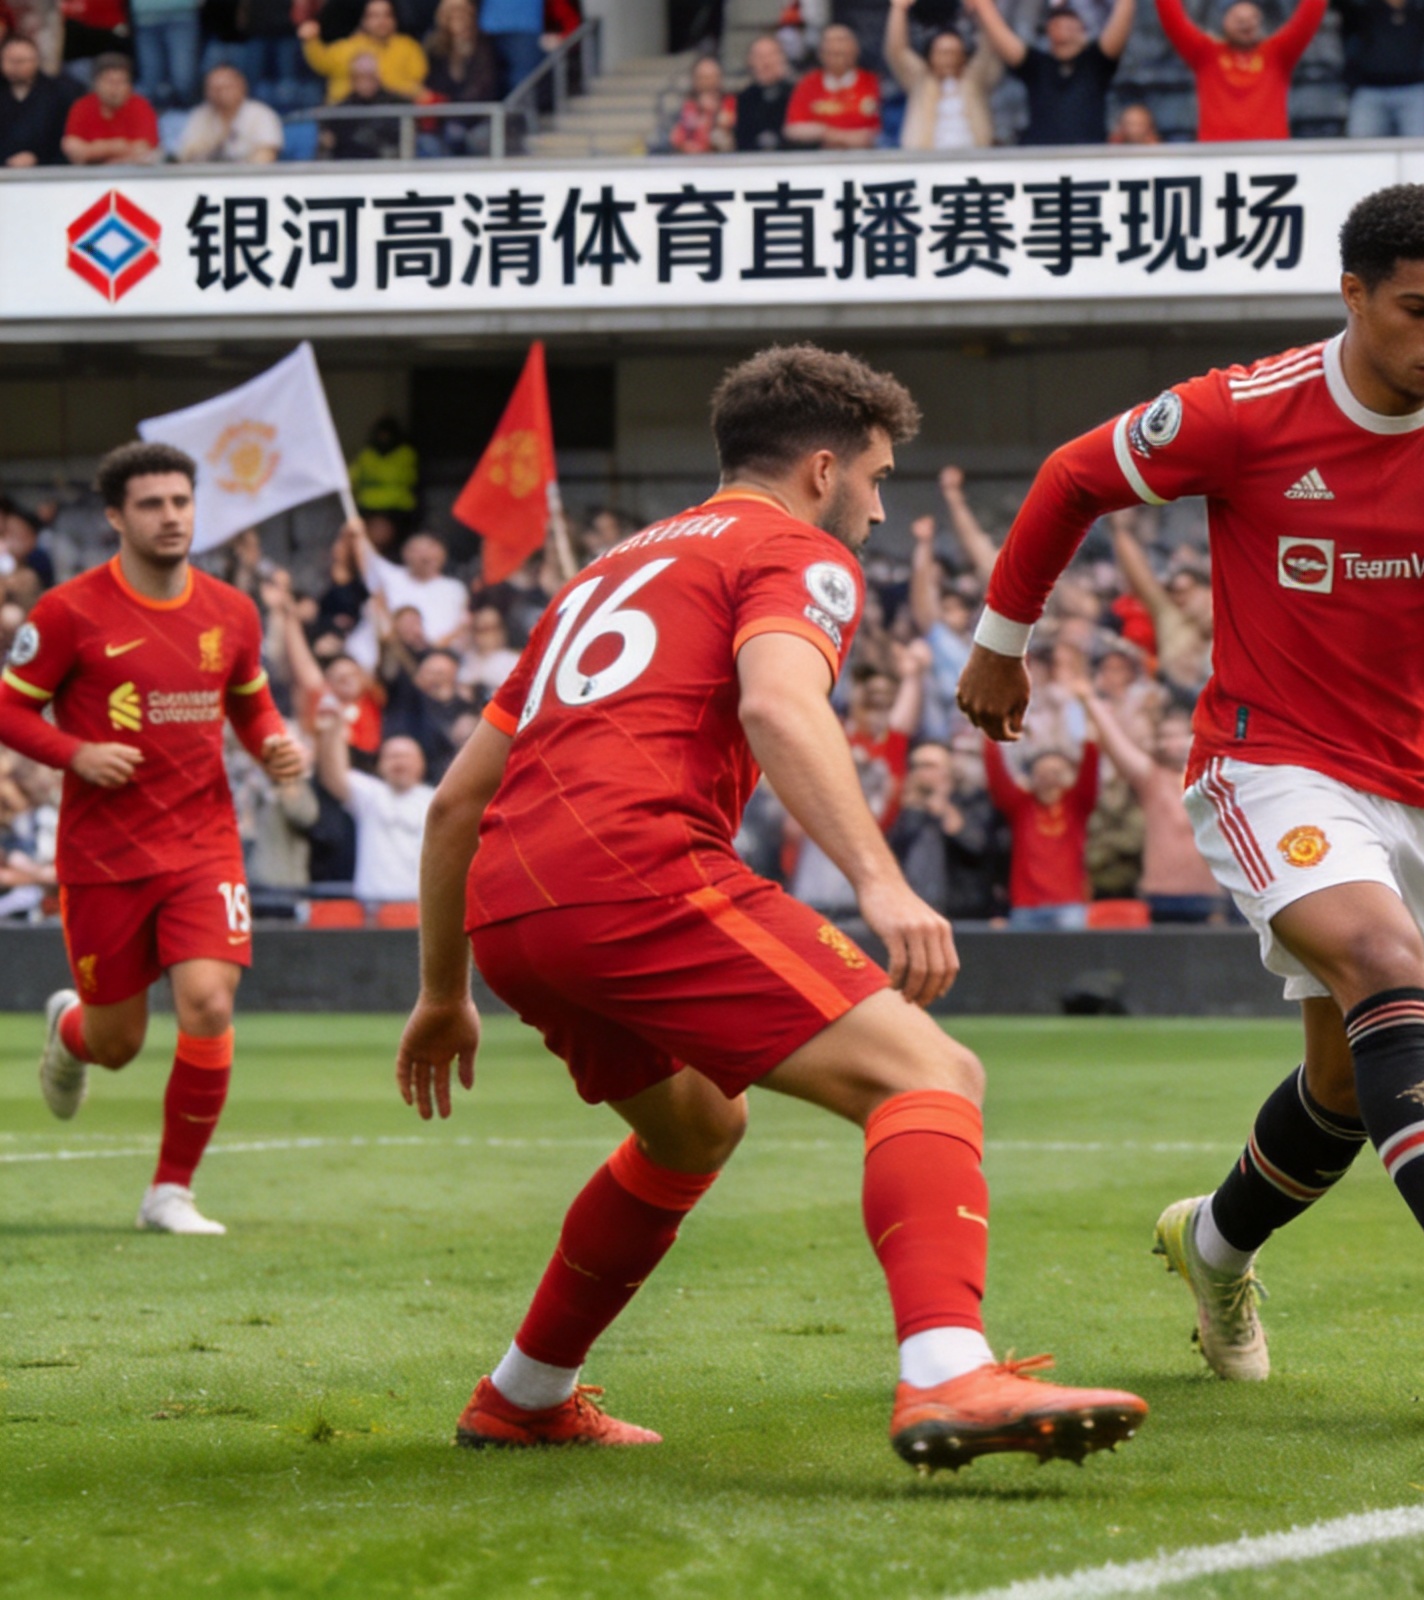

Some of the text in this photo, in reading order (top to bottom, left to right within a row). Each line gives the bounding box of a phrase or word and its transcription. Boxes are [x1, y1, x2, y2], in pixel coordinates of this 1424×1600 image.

[186, 171, 1305, 291] 银河高清体育直播赛事现场
[516, 556, 678, 734] 16
